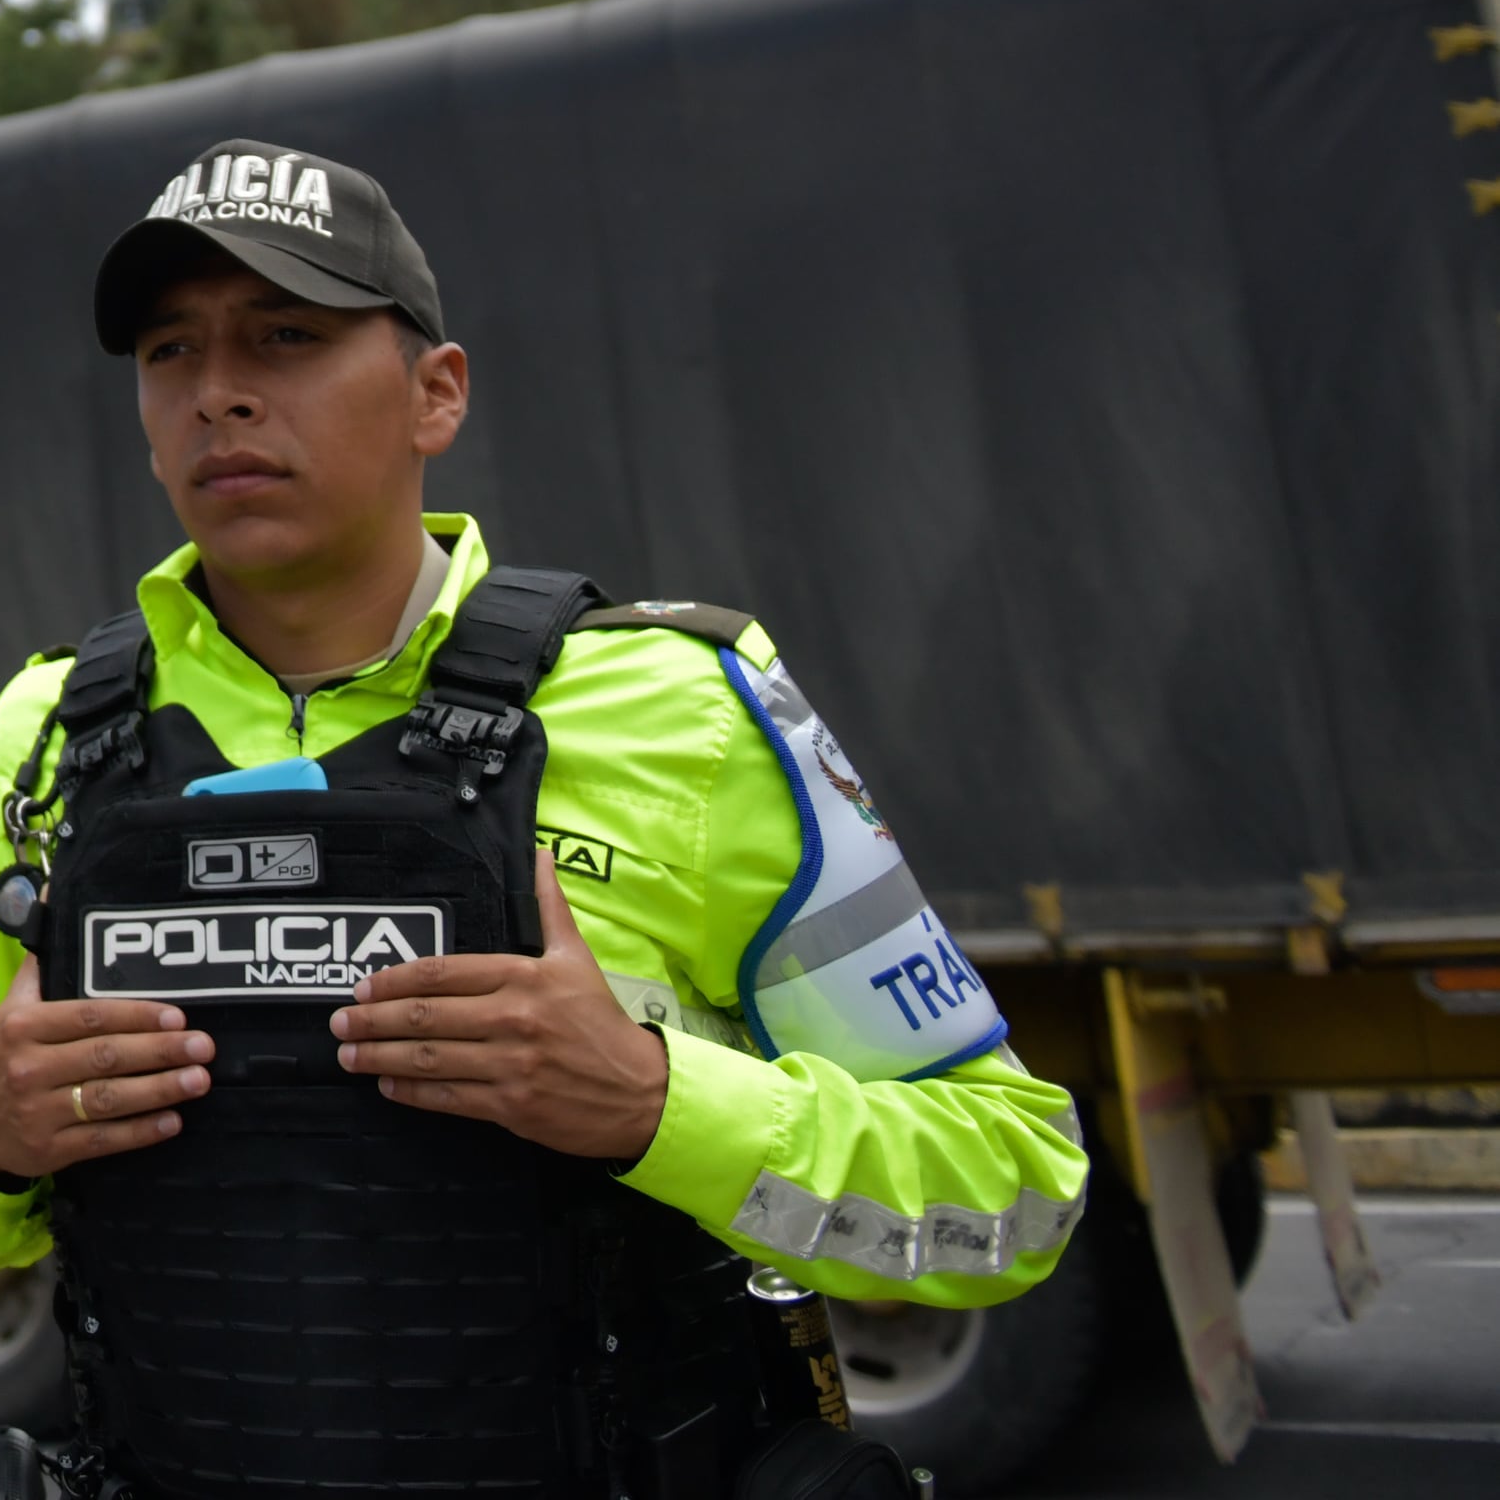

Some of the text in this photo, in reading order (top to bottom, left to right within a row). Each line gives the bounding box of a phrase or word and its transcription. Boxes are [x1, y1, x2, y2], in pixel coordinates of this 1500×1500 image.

[179, 201, 334, 238] NACIONAL
[103, 915, 419, 967] POLICIA
[244, 963, 393, 985] NACION
